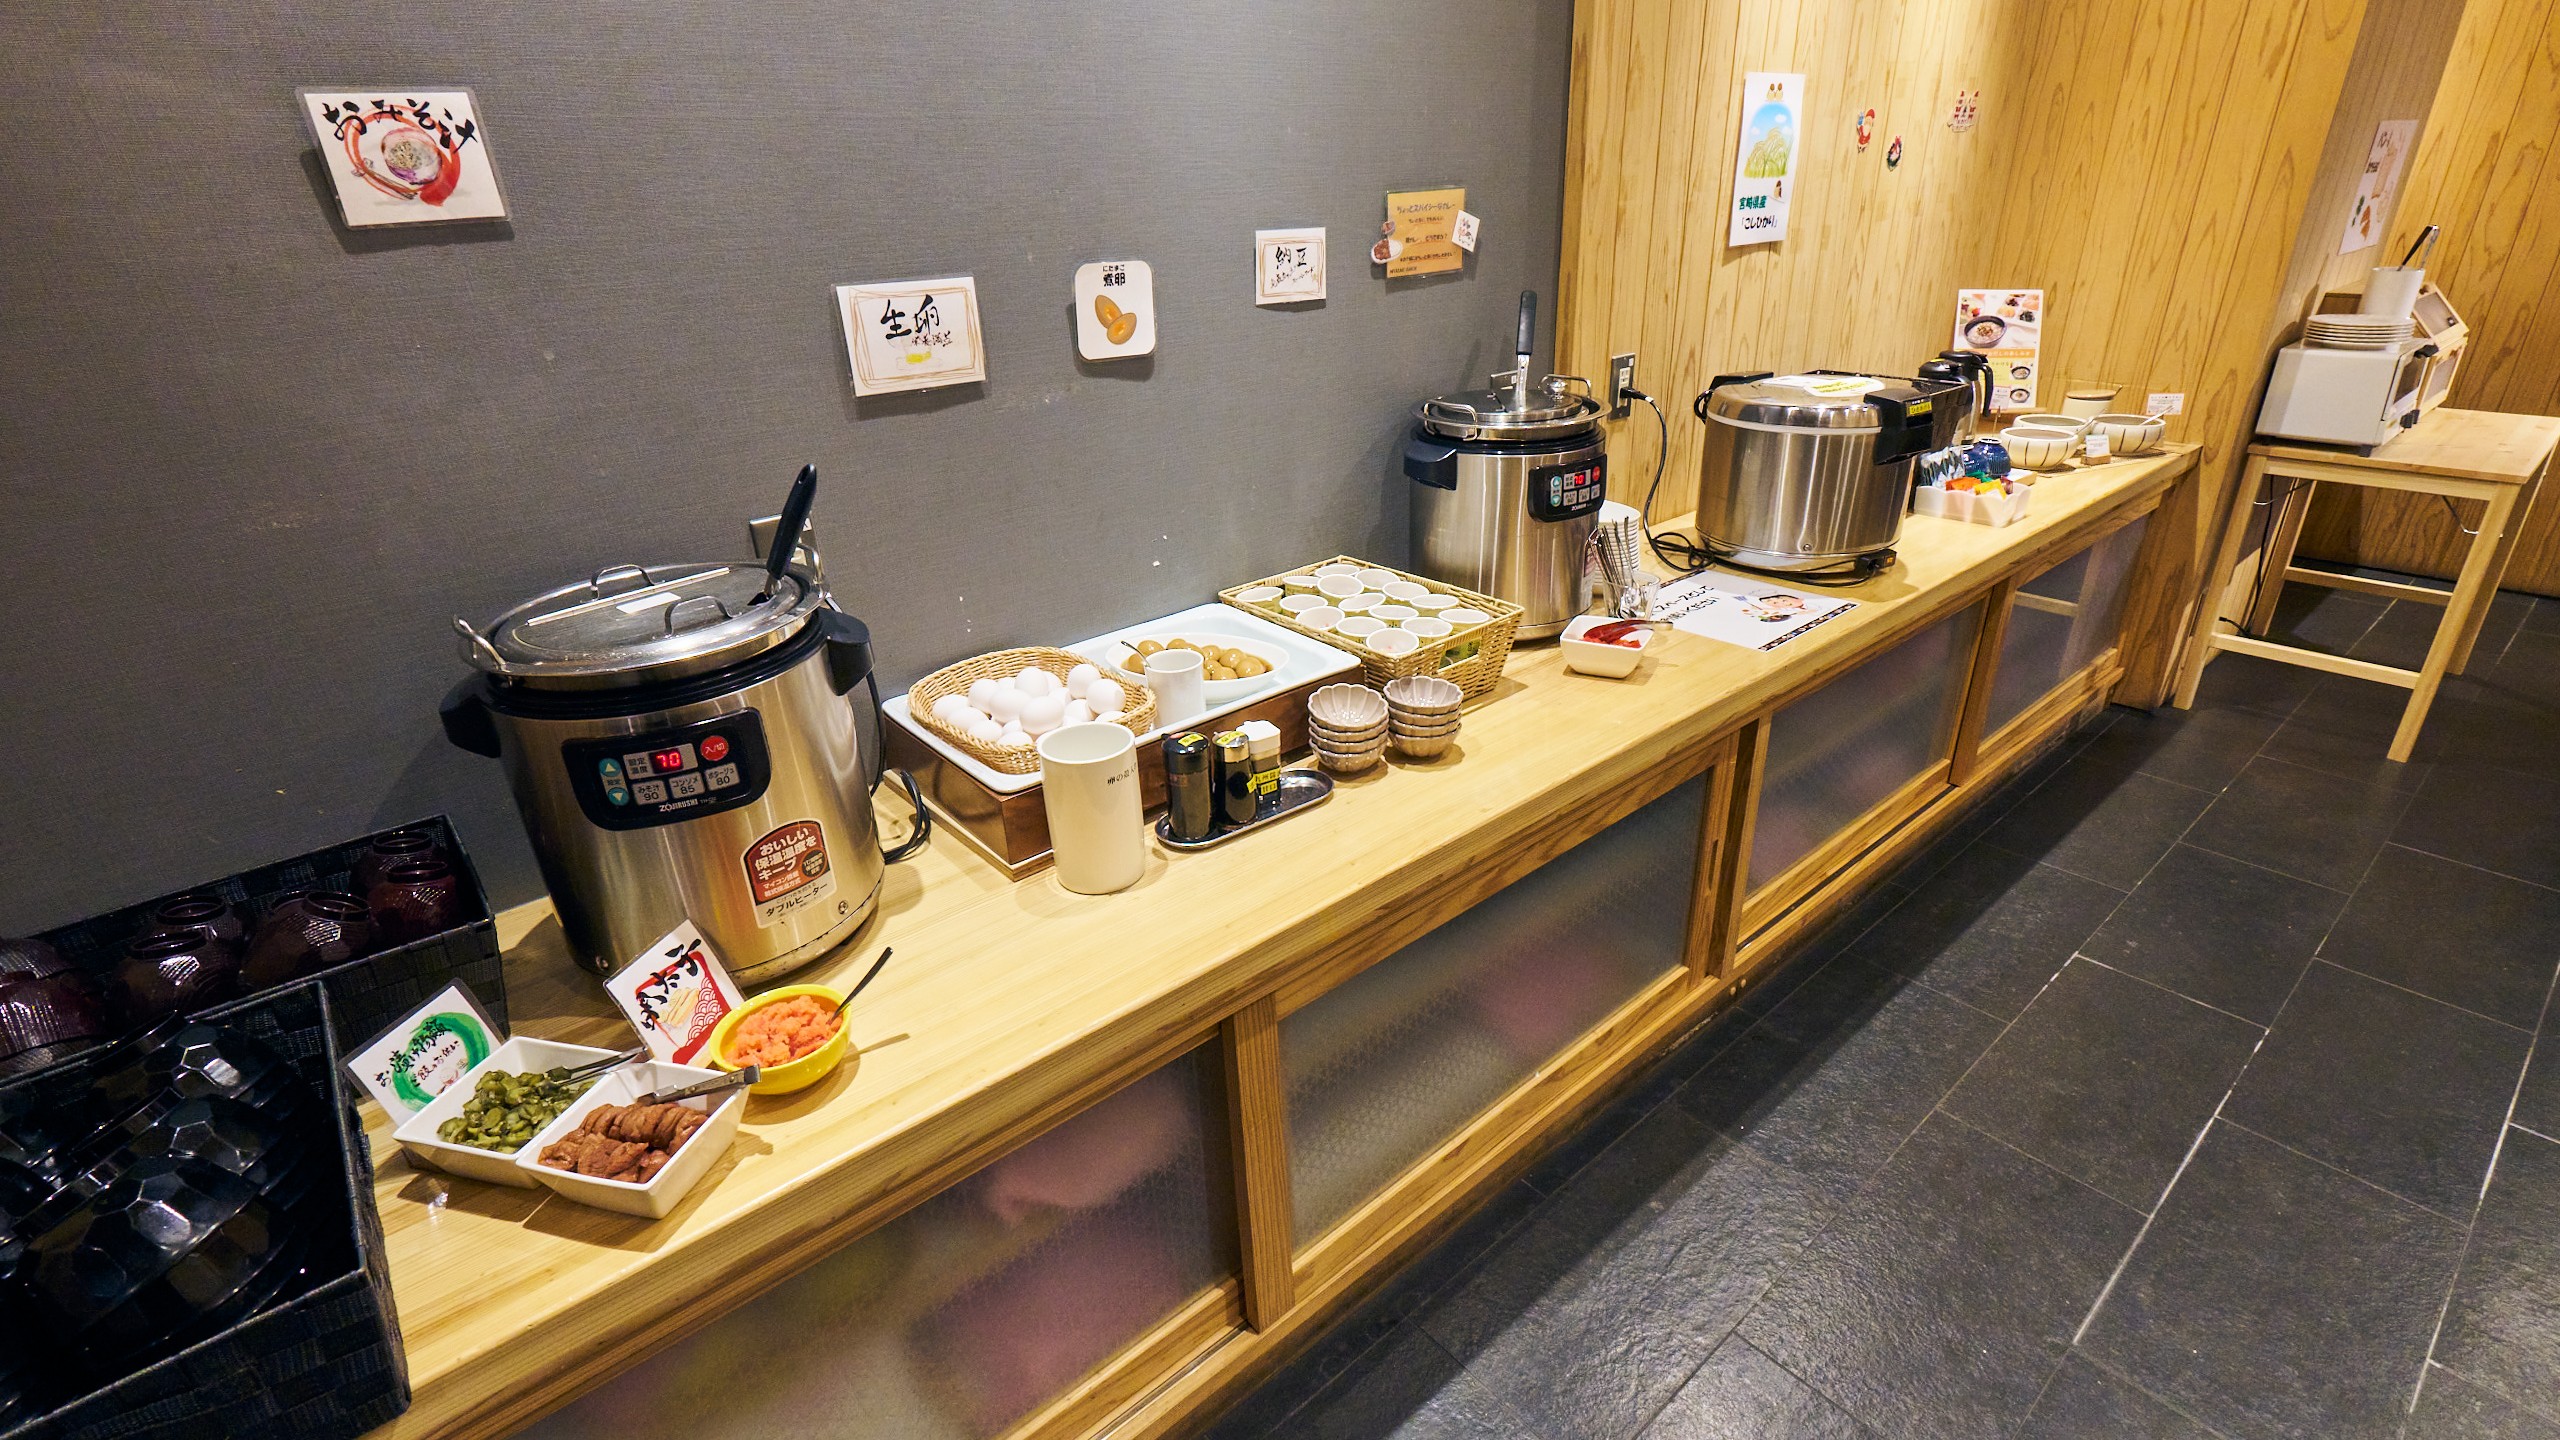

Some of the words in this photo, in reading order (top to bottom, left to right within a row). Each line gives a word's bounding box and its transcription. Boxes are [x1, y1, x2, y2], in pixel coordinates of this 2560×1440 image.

[321, 98, 478, 153] おみそ汁
[1103, 272, 1126, 287] 煮卵
[880, 294, 940, 340] 生卵
[656, 752, 681, 768] 70
[671, 776, 699, 788] コンソメ
[716, 775, 731, 786] 80
[644, 791, 659, 801] 90
[680, 785, 695, 795] 85
[658, 798, 699, 812] ZOJIRUSHI
[760, 828, 809, 856] おいしい
[755, 835, 817, 871] 保温温度を
[758, 857, 797, 880] キープ
[766, 883, 828, 917] ダブルヒーター
